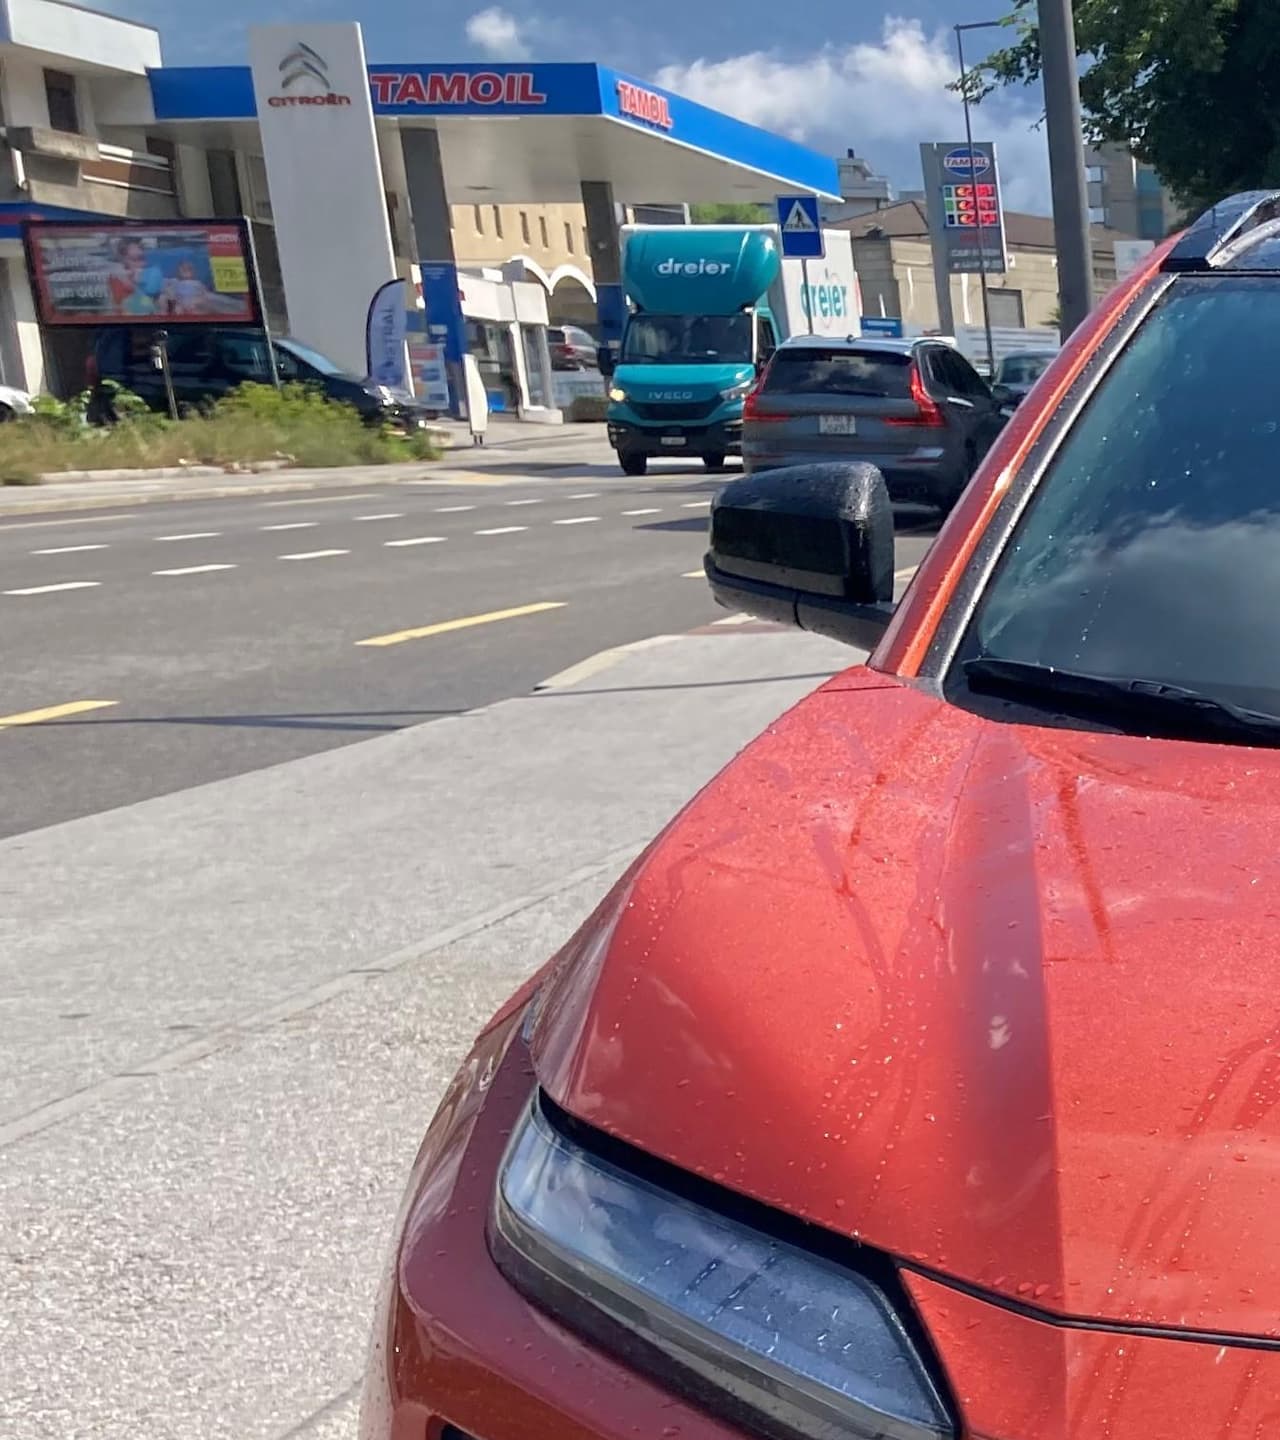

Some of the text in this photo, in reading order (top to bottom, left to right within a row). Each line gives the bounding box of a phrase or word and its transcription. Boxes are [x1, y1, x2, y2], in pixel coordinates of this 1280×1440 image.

[370, 73, 547, 105] TAMOIL
[618, 80, 673, 128] TAMOIL
[658, 258, 731, 275] dreier
[800, 270, 847, 319] dreier
[648, 391, 693, 400] IVECO
